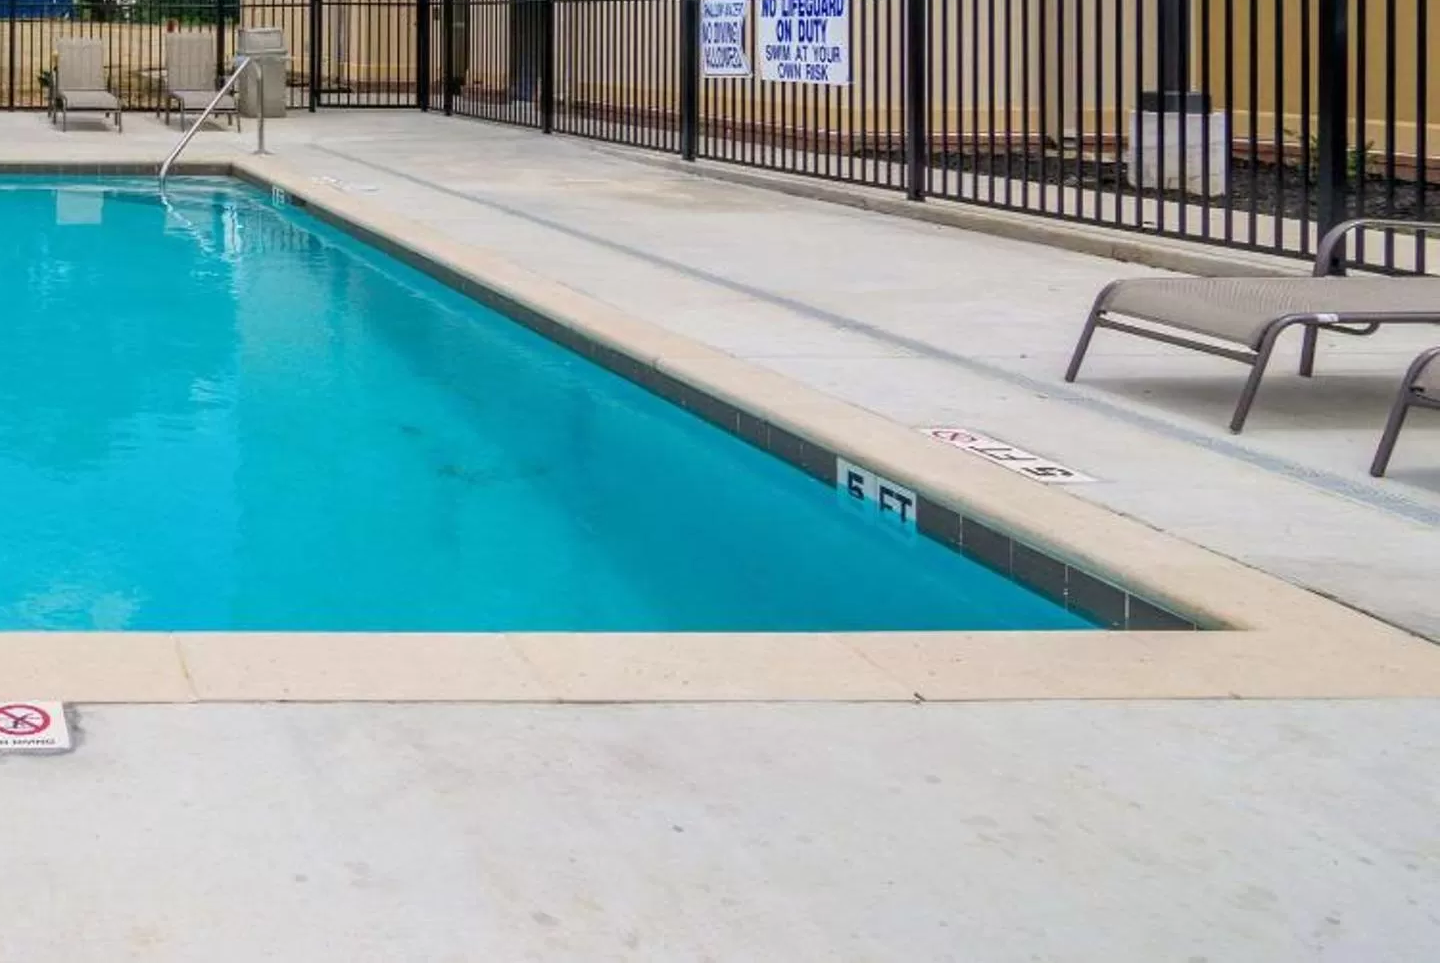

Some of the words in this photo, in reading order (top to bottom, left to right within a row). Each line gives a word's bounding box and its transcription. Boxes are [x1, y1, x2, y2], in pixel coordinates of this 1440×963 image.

[777, 19, 792, 42] ON
[798, 19, 828, 43] DUTY
[766, 45, 790, 61] SWIM
[796, 45, 808, 61] AT
[813, 46, 841, 63] YOUR
[778, 63, 801, 79] OWN
[806, 64, 828, 80] RISK
[968, 446, 1037, 461] FT
[1021, 467, 1074, 477] 5
[848, 470, 865, 501] 5
[879, 485, 913, 524] FT
